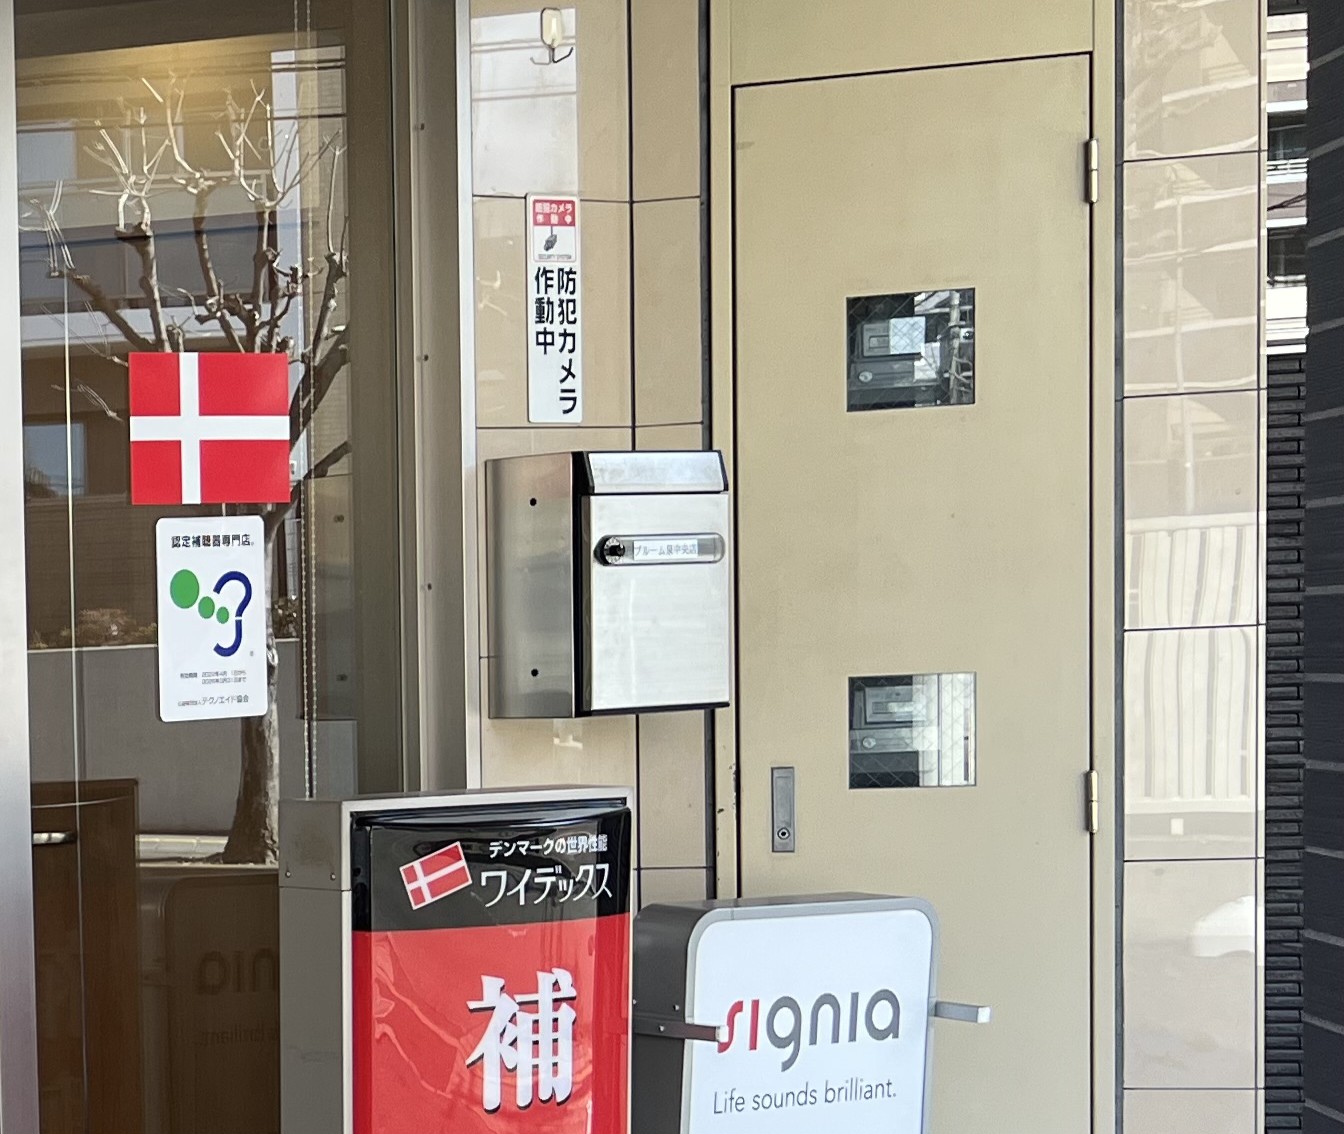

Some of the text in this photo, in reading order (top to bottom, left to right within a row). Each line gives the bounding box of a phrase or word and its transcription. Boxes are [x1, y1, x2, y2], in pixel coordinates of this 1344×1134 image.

[534, 266, 555, 355] 作動中
[557, 266, 578, 415] 防犯カメラ
[488, 832, 608, 858] デンマークの世界性能
[479, 862, 613, 908] ワイデックス
[716, 987, 901, 1073] signia
[713, 1076, 898, 1114] Life sounds brilliant.
